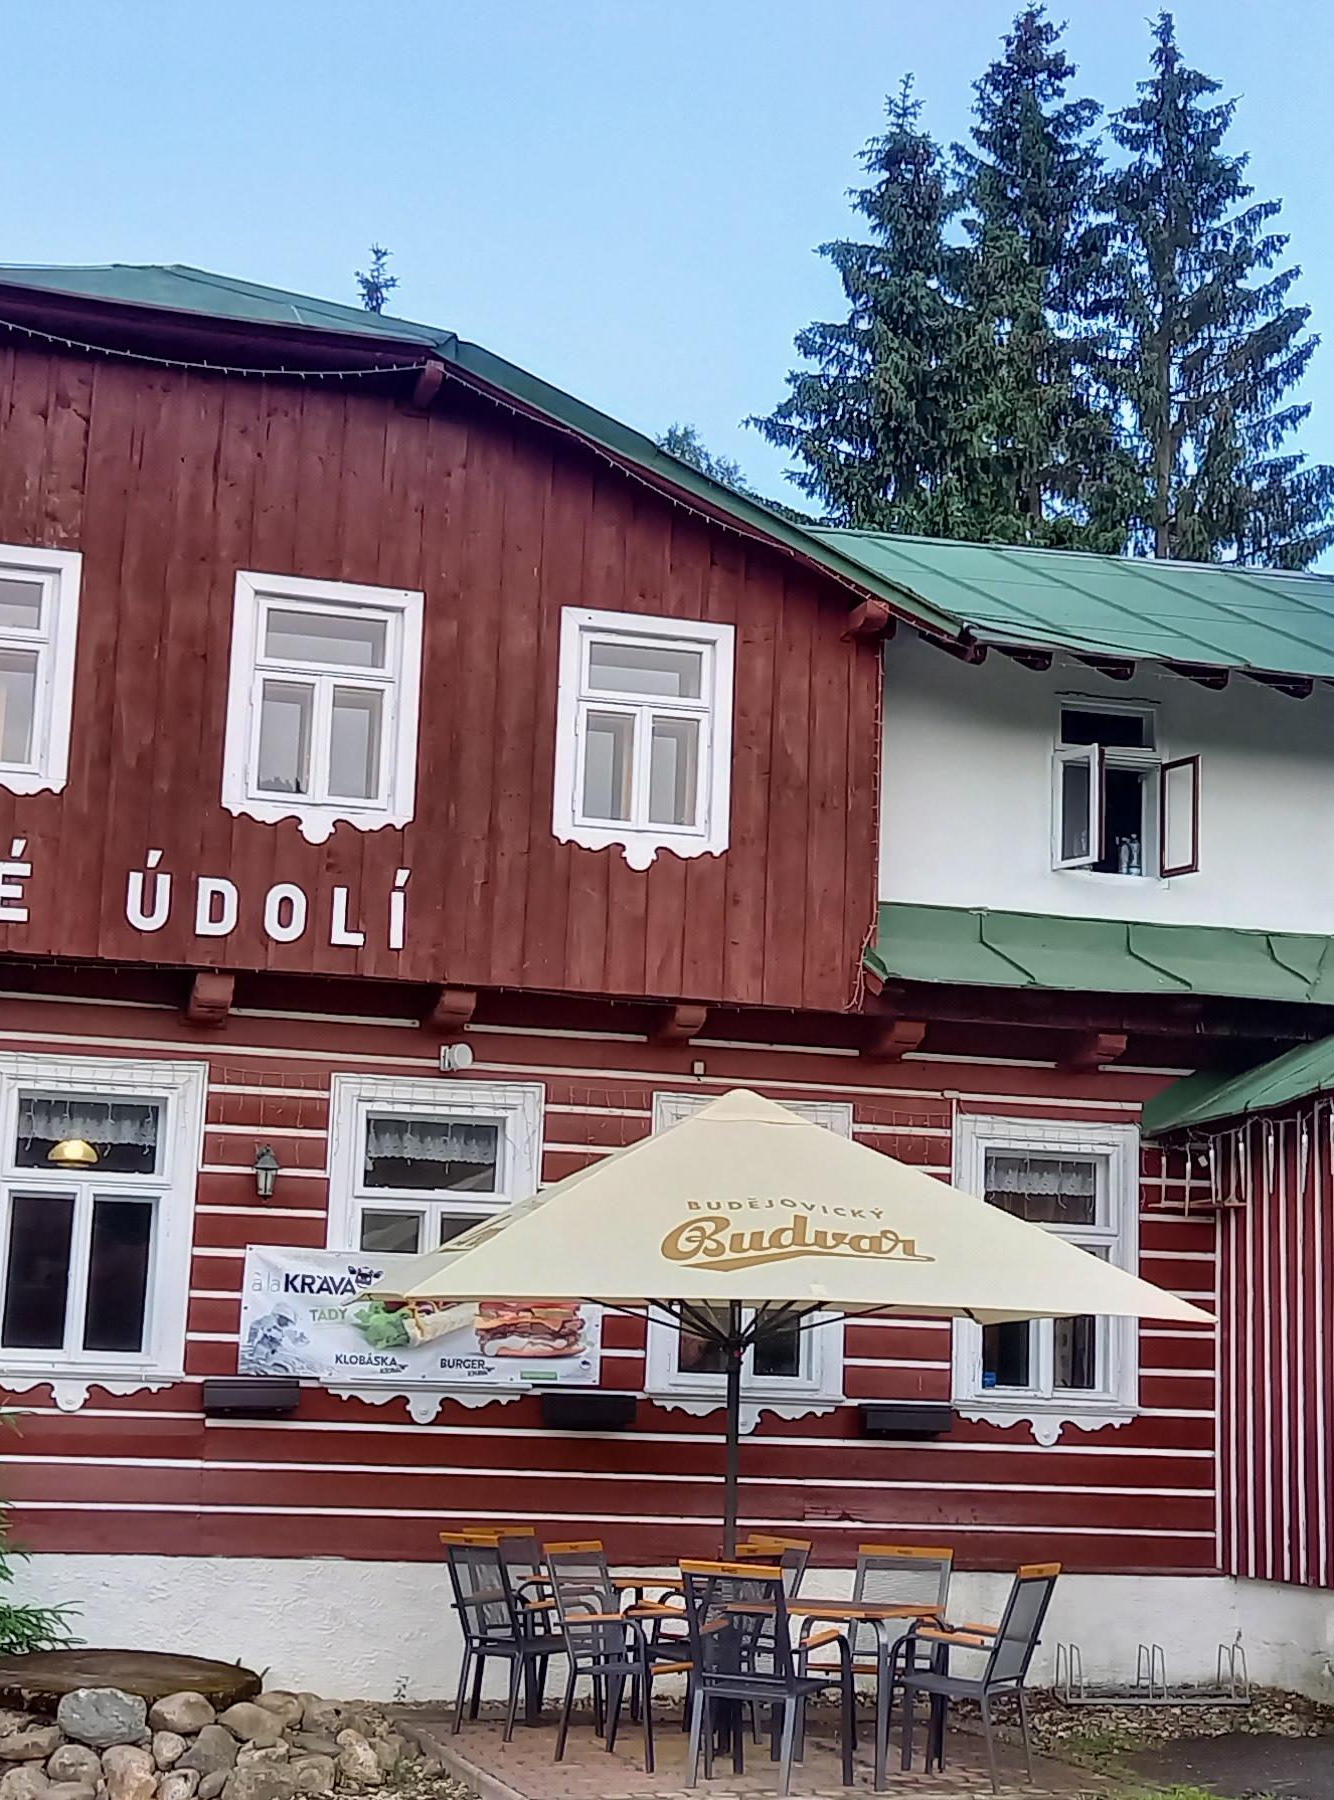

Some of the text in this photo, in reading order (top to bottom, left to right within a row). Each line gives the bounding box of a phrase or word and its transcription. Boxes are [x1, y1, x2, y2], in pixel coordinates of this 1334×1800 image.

[125, 849, 411, 949] ÚDOLÍ
[687, 1198, 884, 1220] BUDĚJOVICKÝ
[661, 1214, 935, 1270] Budvar
[309, 1308, 348, 1322] TADY
[335, 1352, 398, 1367] KLOBÁSKA
[440, 1358, 485, 1370] BURGER
